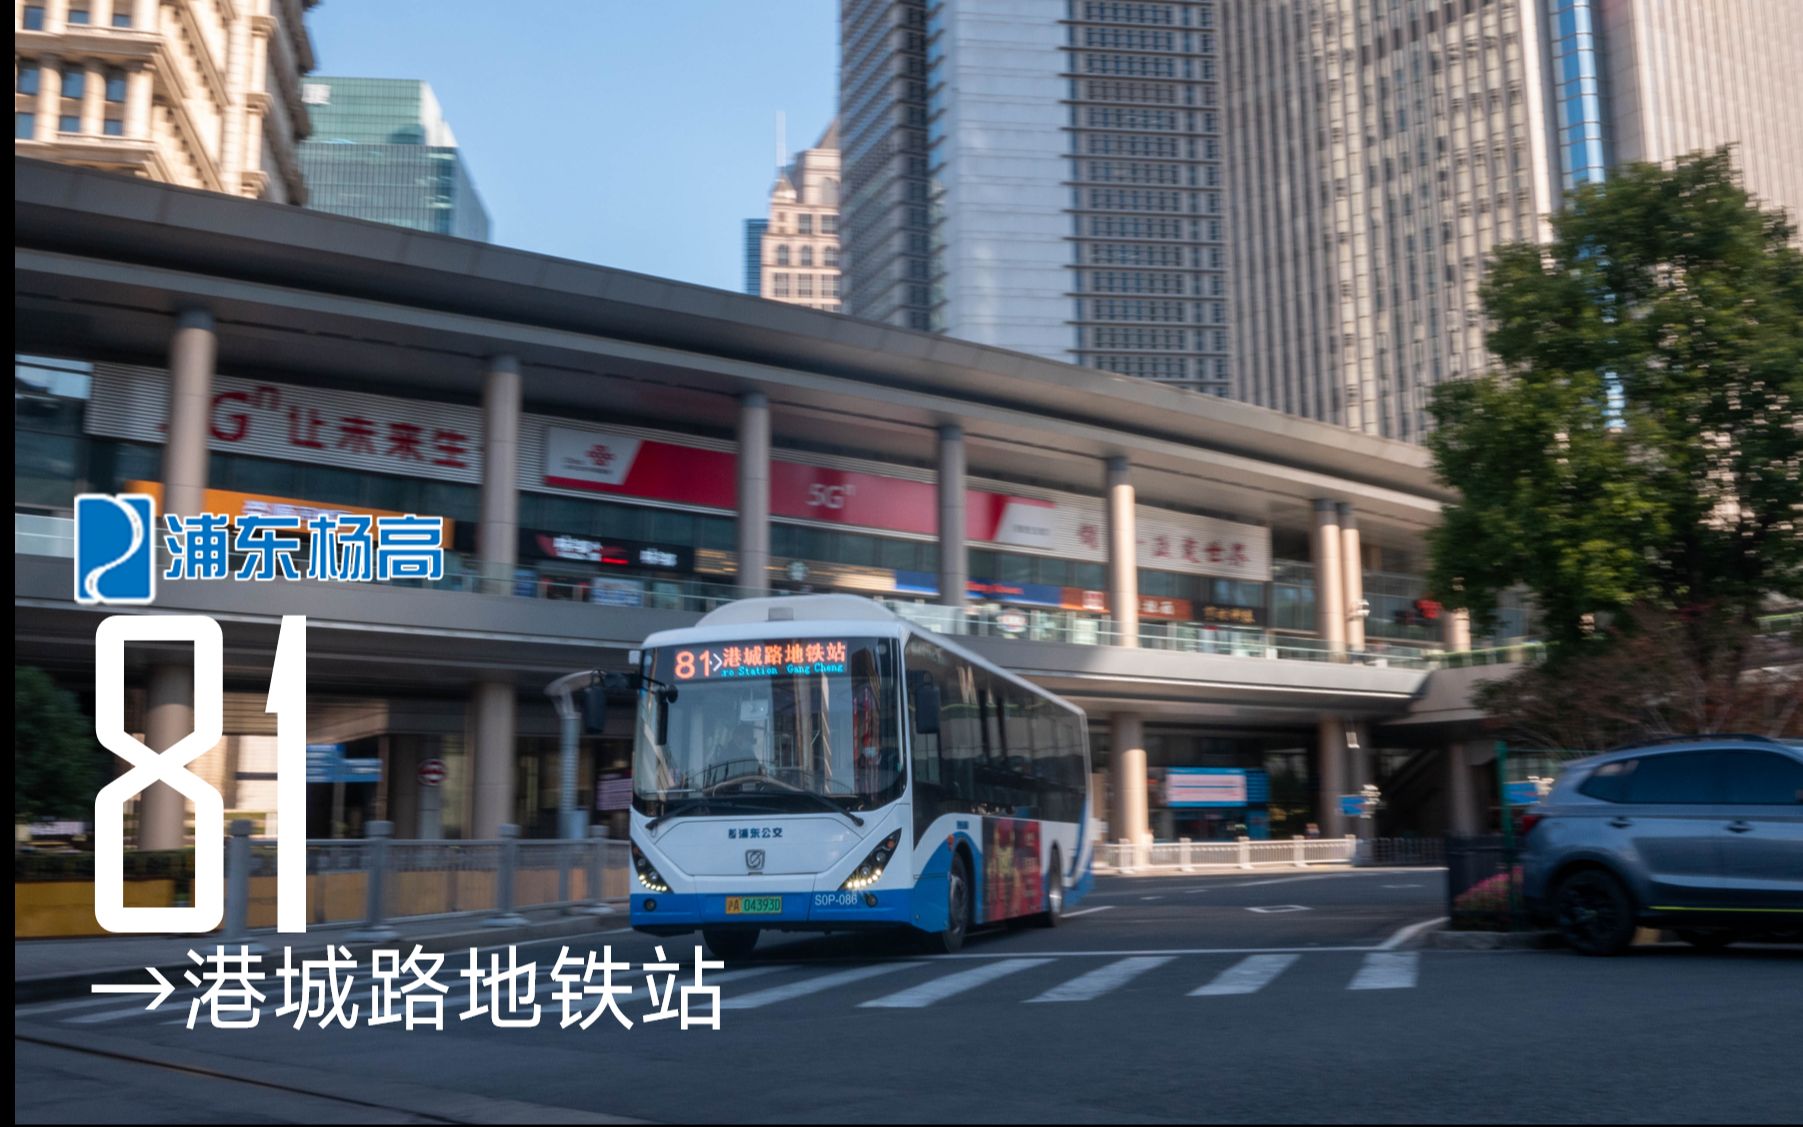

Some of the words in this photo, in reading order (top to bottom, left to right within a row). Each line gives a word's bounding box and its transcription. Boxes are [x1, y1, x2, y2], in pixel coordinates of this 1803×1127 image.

[288, 407, 482, 469] 让未来生
[675, 650, 711, 680] 81
[722, 642, 846, 668] 港城路地铁站
[738, 665, 778, 677] Station
[786, 663, 811, 675] Gang
[814, 661, 844, 674] Cheng
